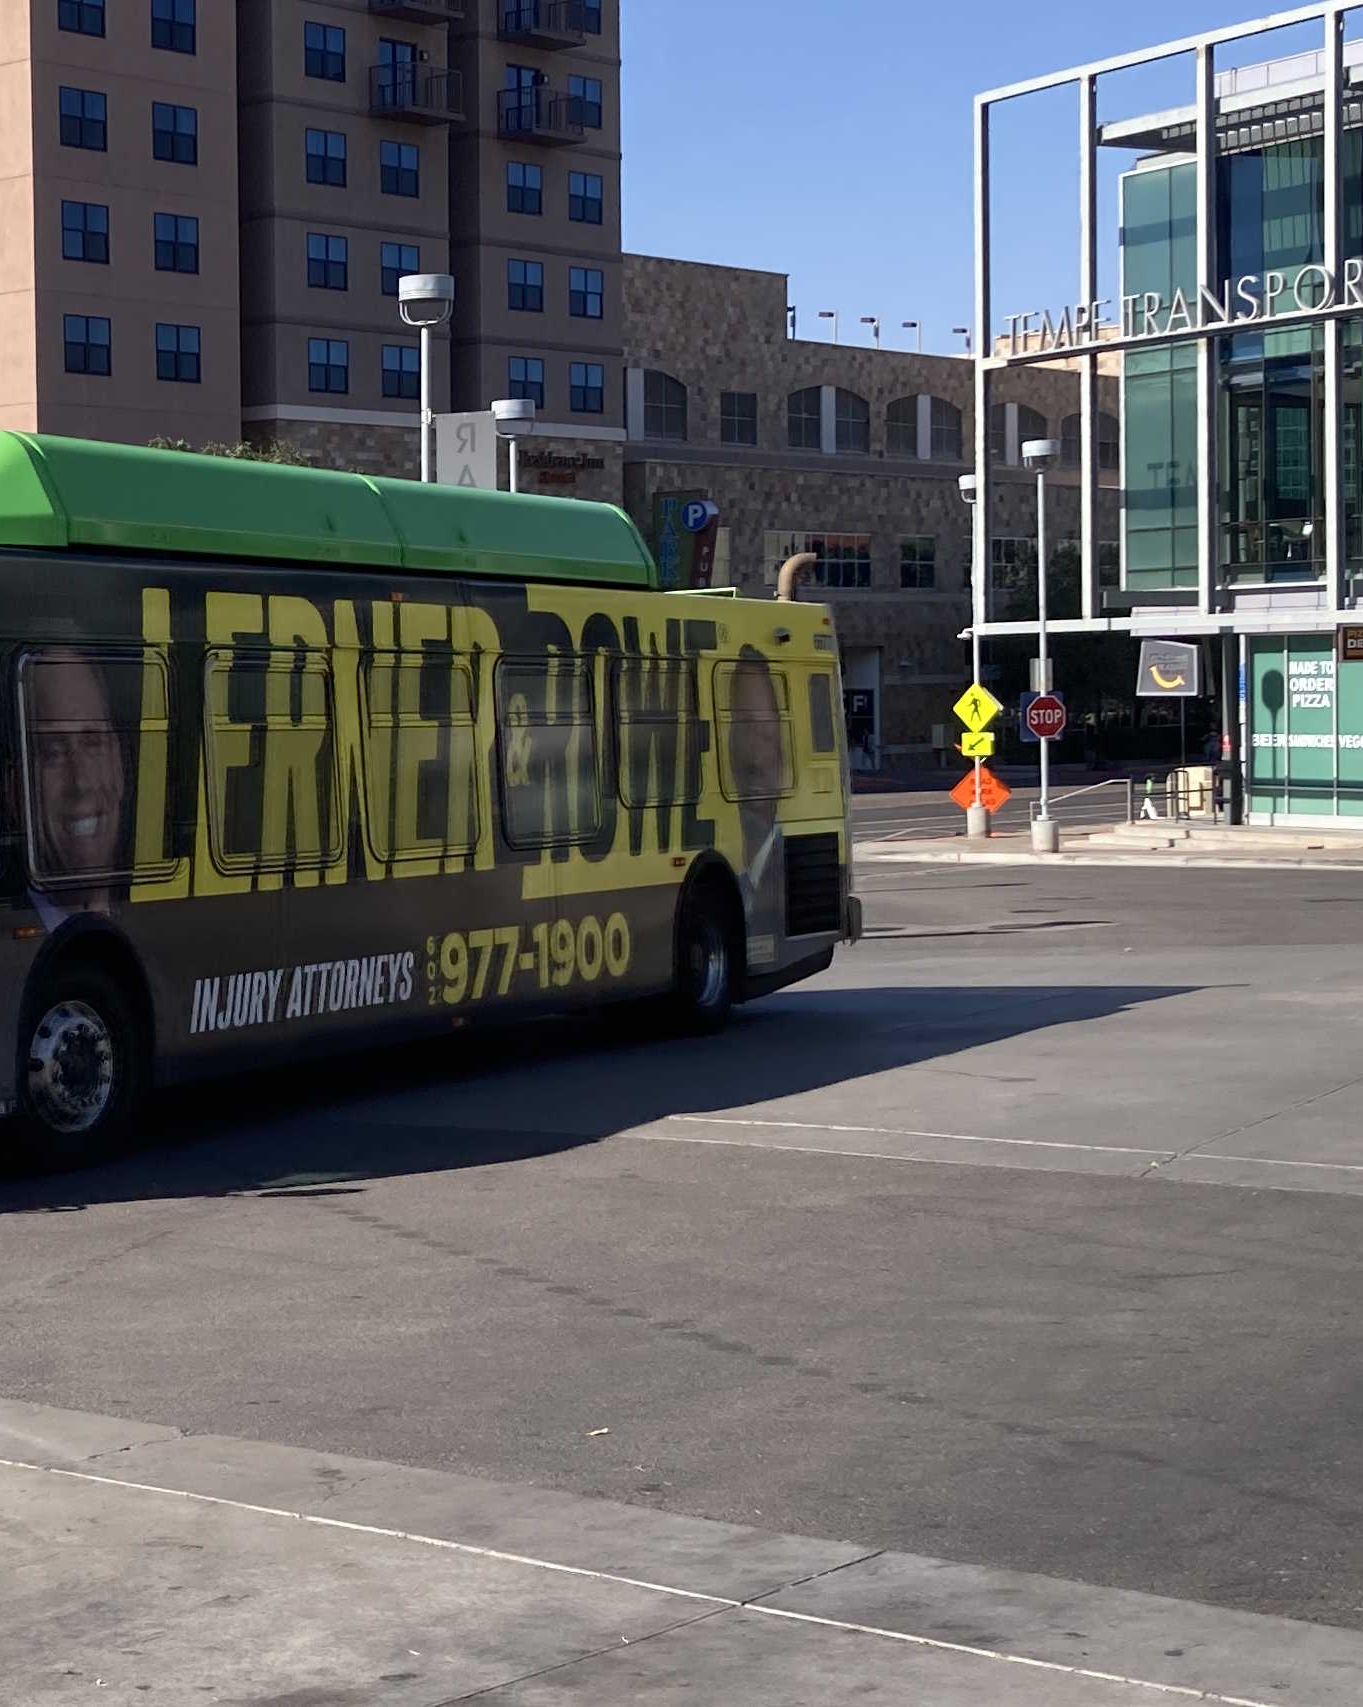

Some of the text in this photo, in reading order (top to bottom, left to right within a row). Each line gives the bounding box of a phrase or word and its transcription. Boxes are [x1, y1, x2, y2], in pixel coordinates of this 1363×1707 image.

[1004, 259, 1363, 356] TEMPE TRANSPOR
[687, 505, 704, 528] P
[1289, 660, 1318, 675] MADE
[1289, 677, 1335, 692] ORDER
[1292, 693, 1332, 708] PIZZA
[1030, 708, 1062, 725] STOP
[130, 587, 718, 903] LERNER & ROWE
[440, 911, 631, 1005] 977-1900
[189, 951, 414, 1034] INJURY ATTORNEYS
